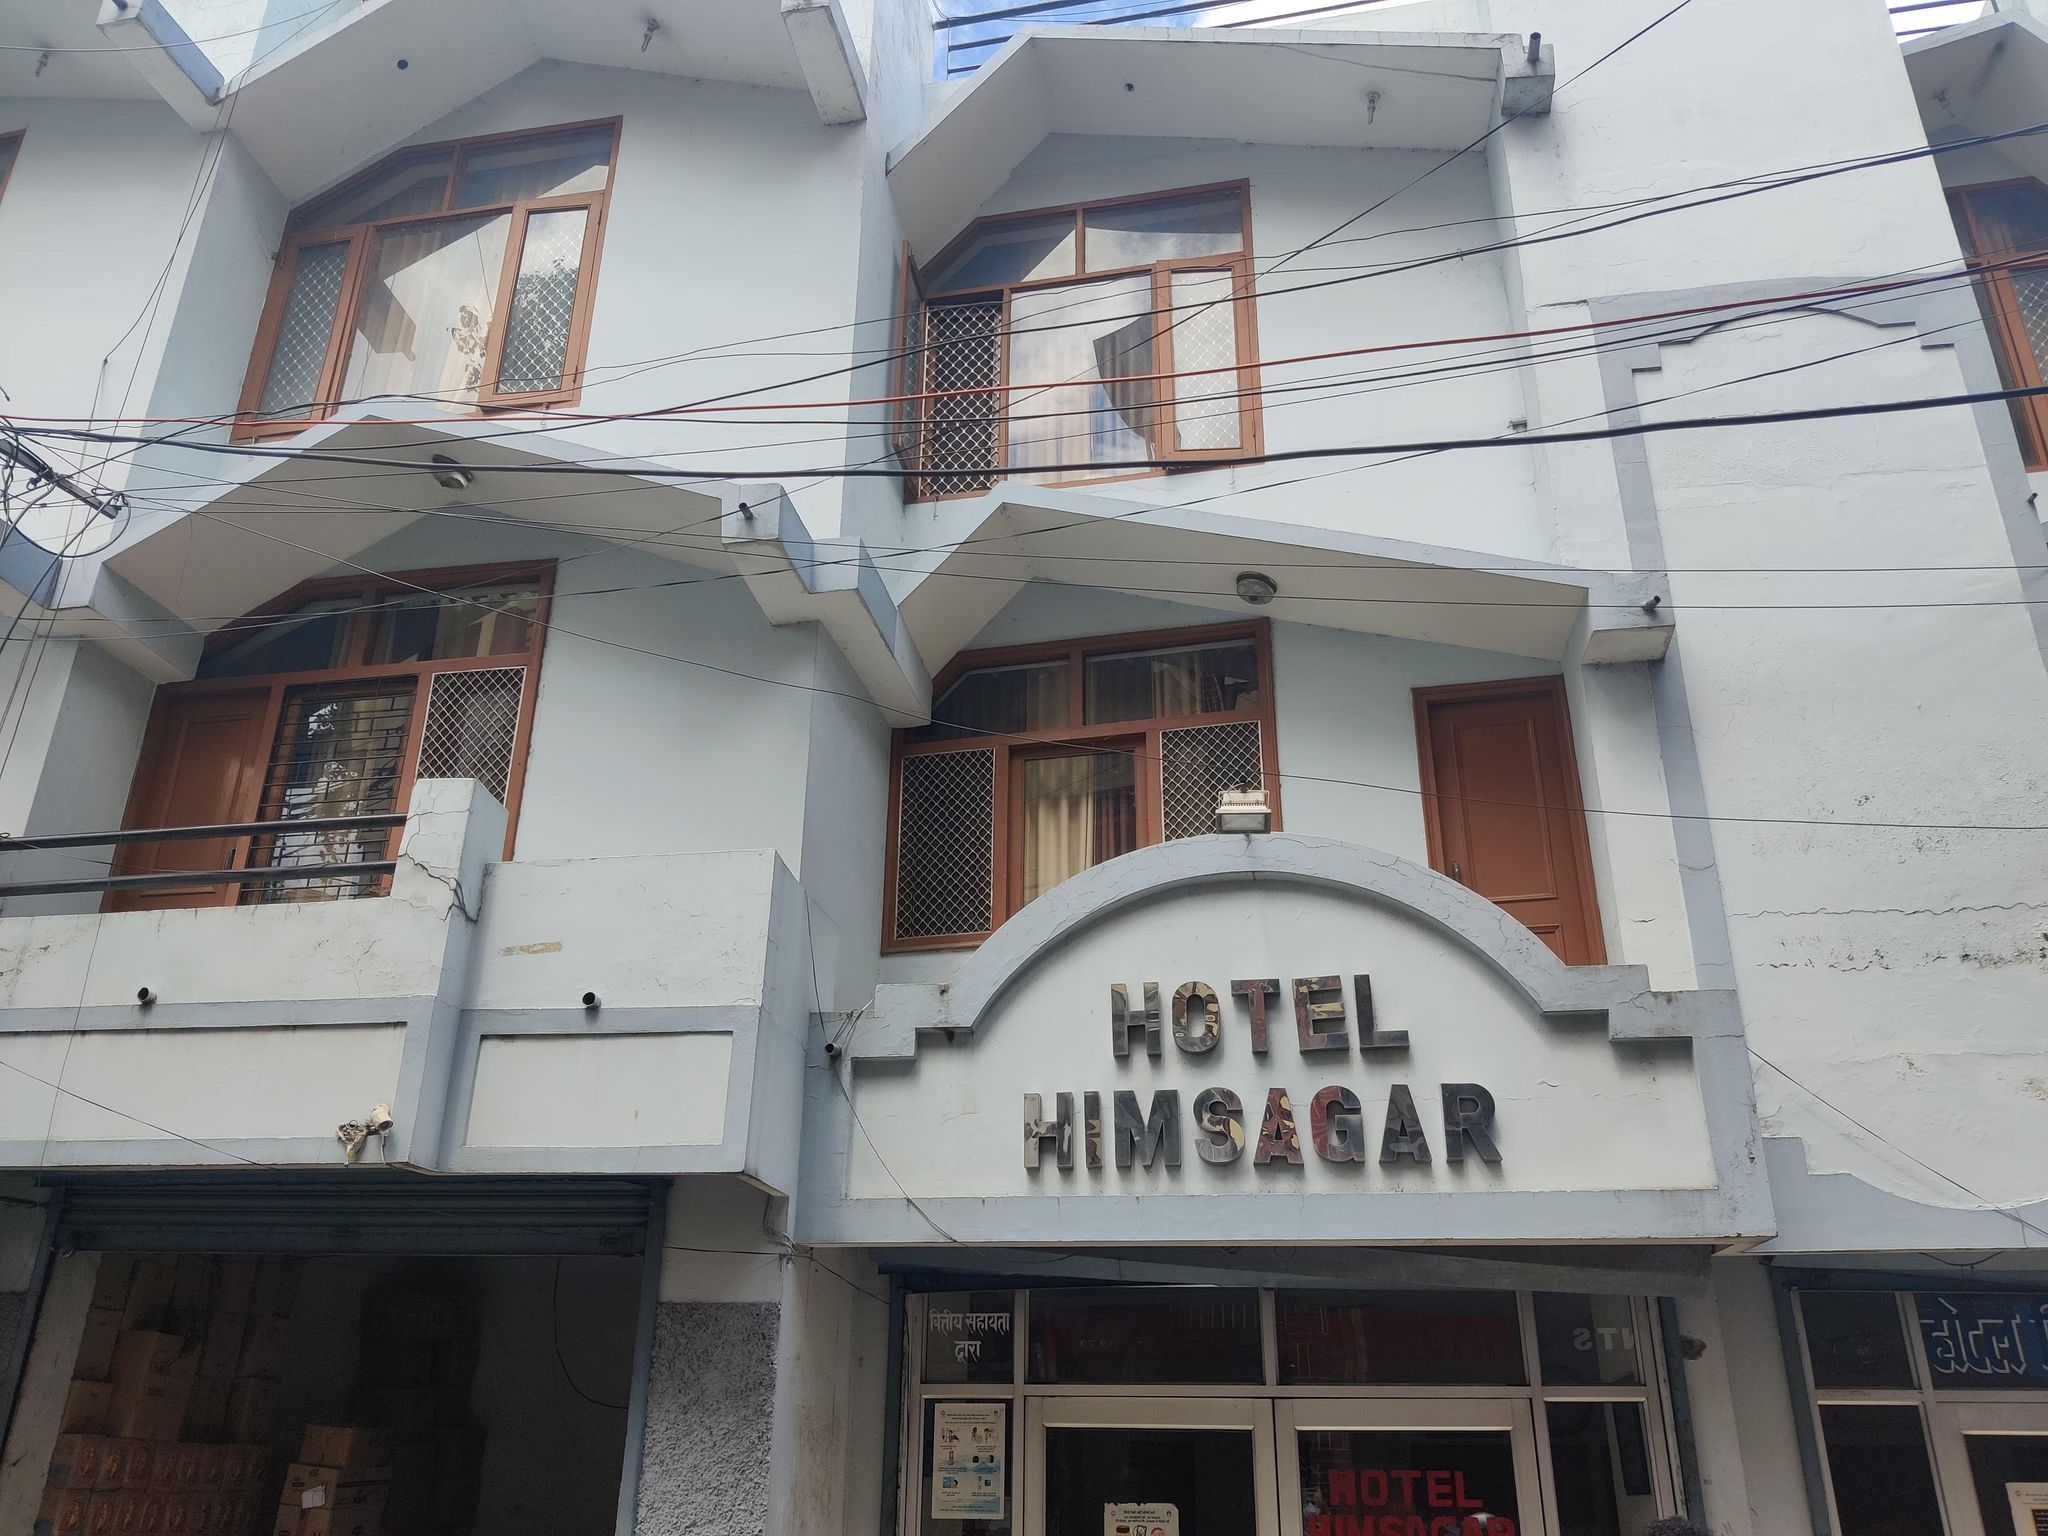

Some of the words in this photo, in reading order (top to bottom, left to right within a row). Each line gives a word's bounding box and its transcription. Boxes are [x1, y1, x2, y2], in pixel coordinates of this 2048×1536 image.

[1111, 974, 1410, 1057] HOTEL
[1024, 1083, 1503, 1169] HIMSAGAR
[929, 1308, 964, 1336] वित्तीय
[965, 1312, 1010, 1336] सहायता
[953, 1340, 982, 1363] द्वारा
[1328, 1469, 1483, 1508] HOTEL
